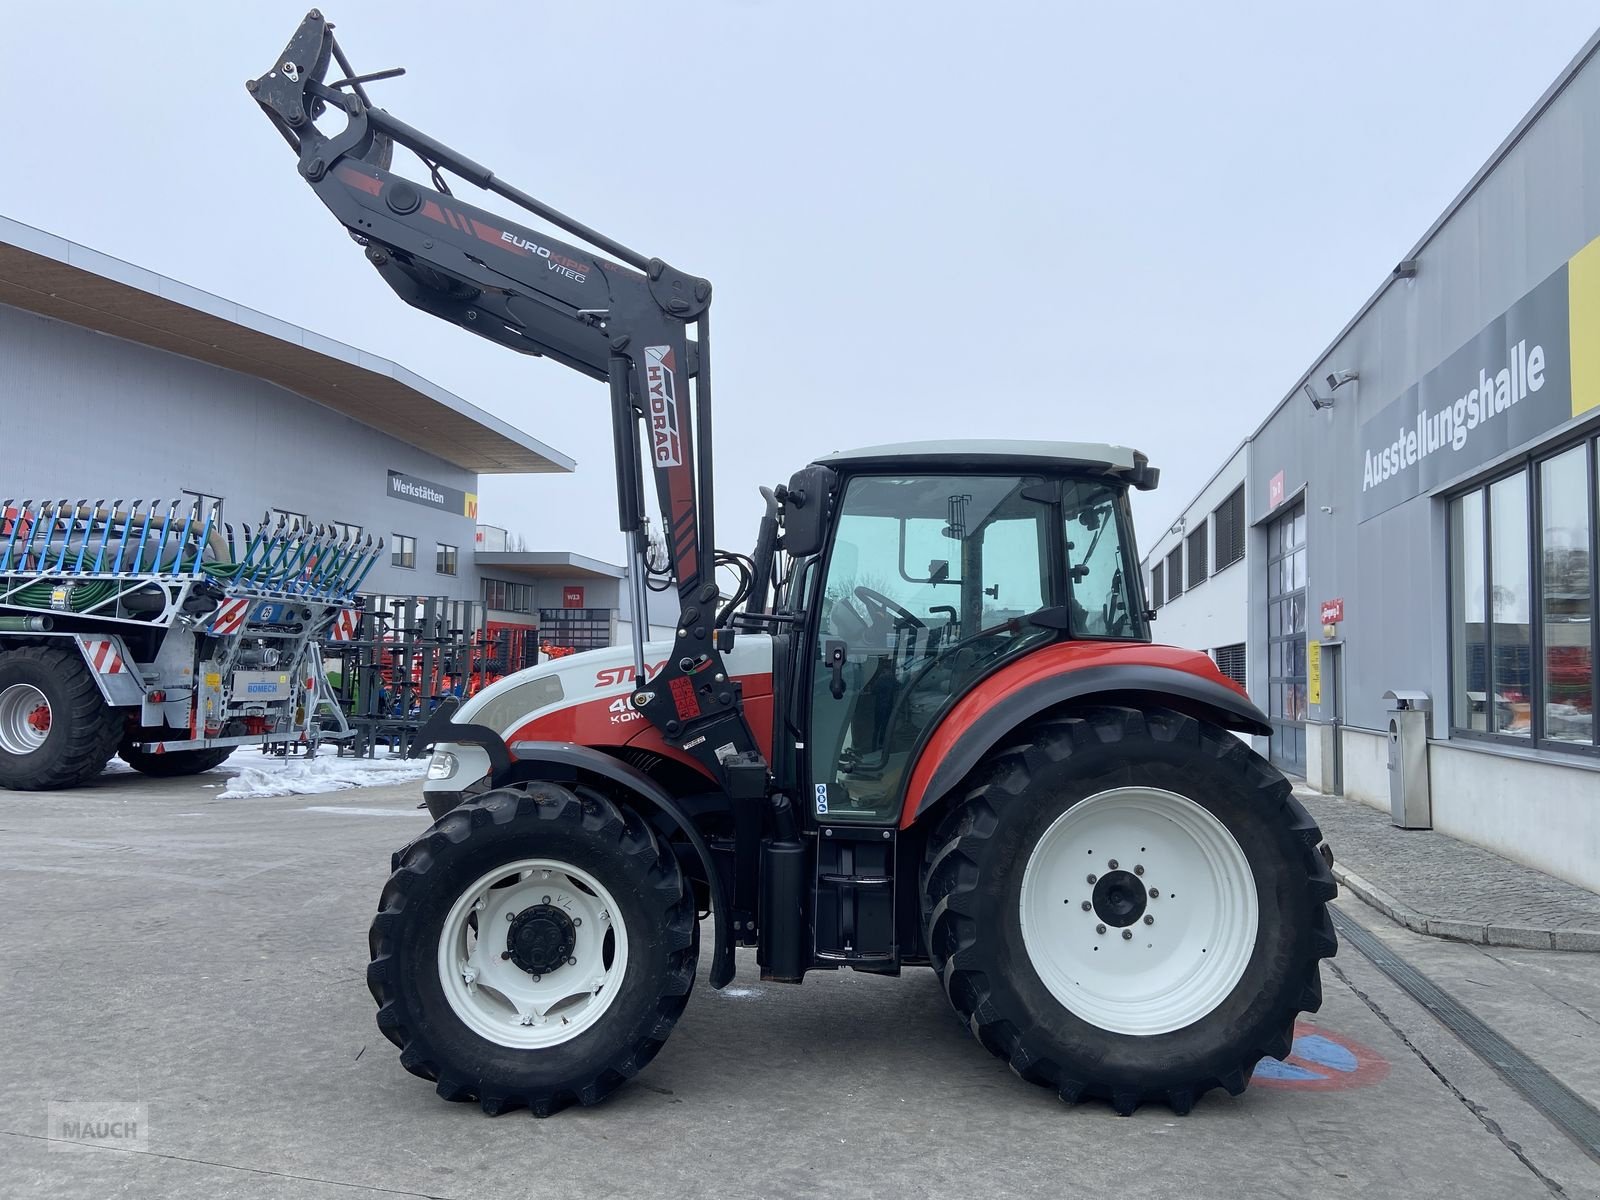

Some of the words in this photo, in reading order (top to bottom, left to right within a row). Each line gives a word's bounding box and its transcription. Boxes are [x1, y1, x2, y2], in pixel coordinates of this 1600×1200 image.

[647, 366, 670, 462] HYDRAC
[1362, 338, 1546, 493] Ausstellungshalle
[392, 477, 445, 505] Werkstätten
[261, 607, 273, 618] 25
[247, 682, 278, 694] BOMECH
